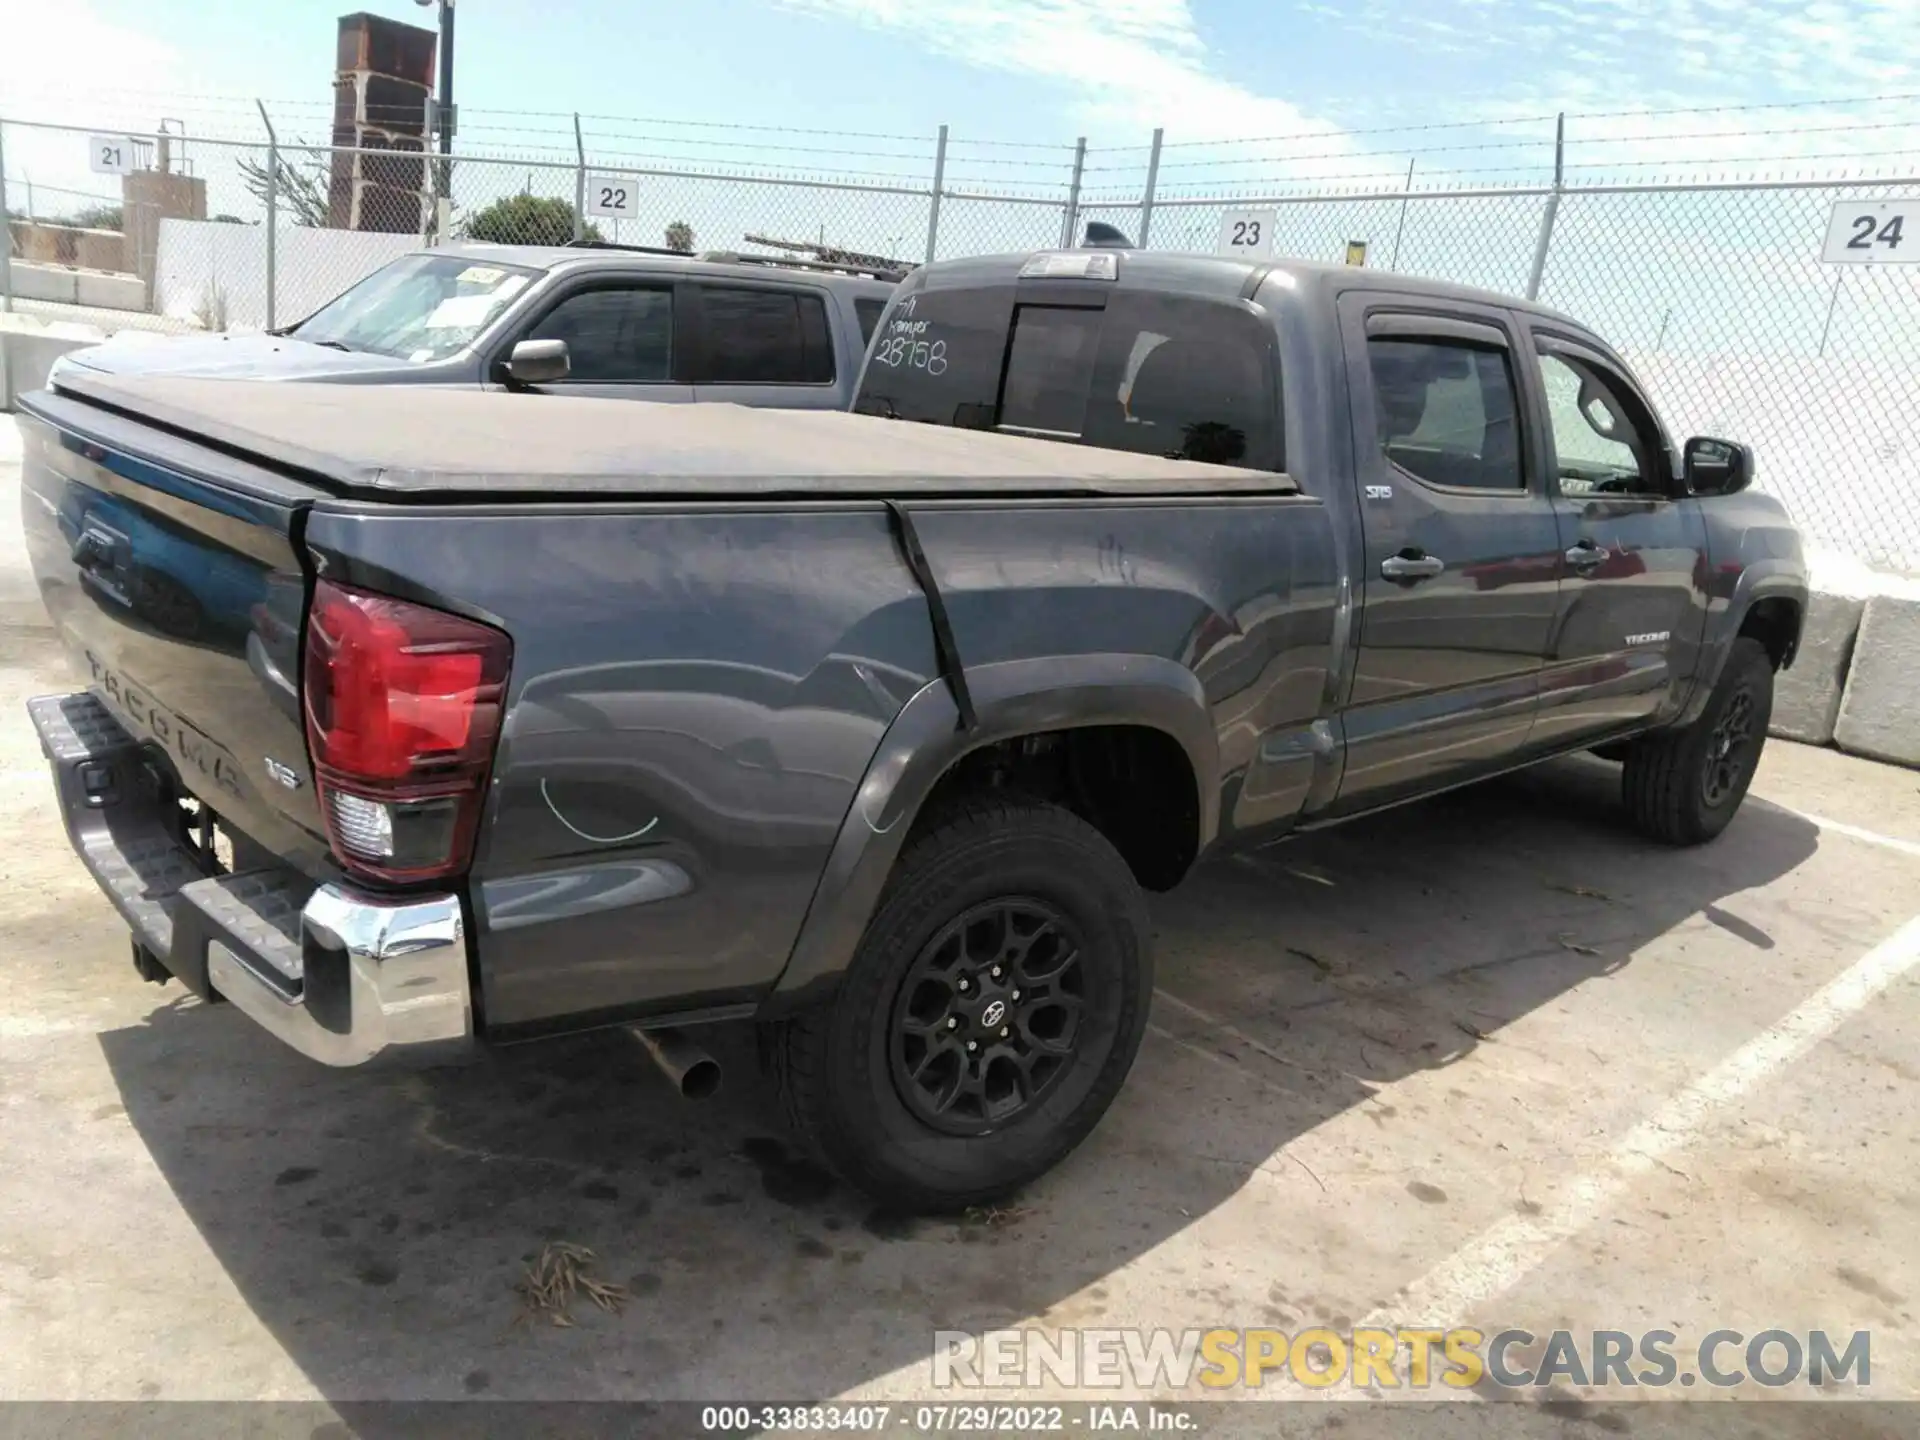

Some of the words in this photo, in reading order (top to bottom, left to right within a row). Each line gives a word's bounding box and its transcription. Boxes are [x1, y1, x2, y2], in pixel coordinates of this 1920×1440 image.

[101, 146, 121, 167] 21
[600, 187, 626, 209] 22
[1231, 220, 1261, 246] 23
[1846, 215, 1904, 249] 24
[875, 337, 948, 375] 28758
[84, 649, 246, 802] TACOMA
